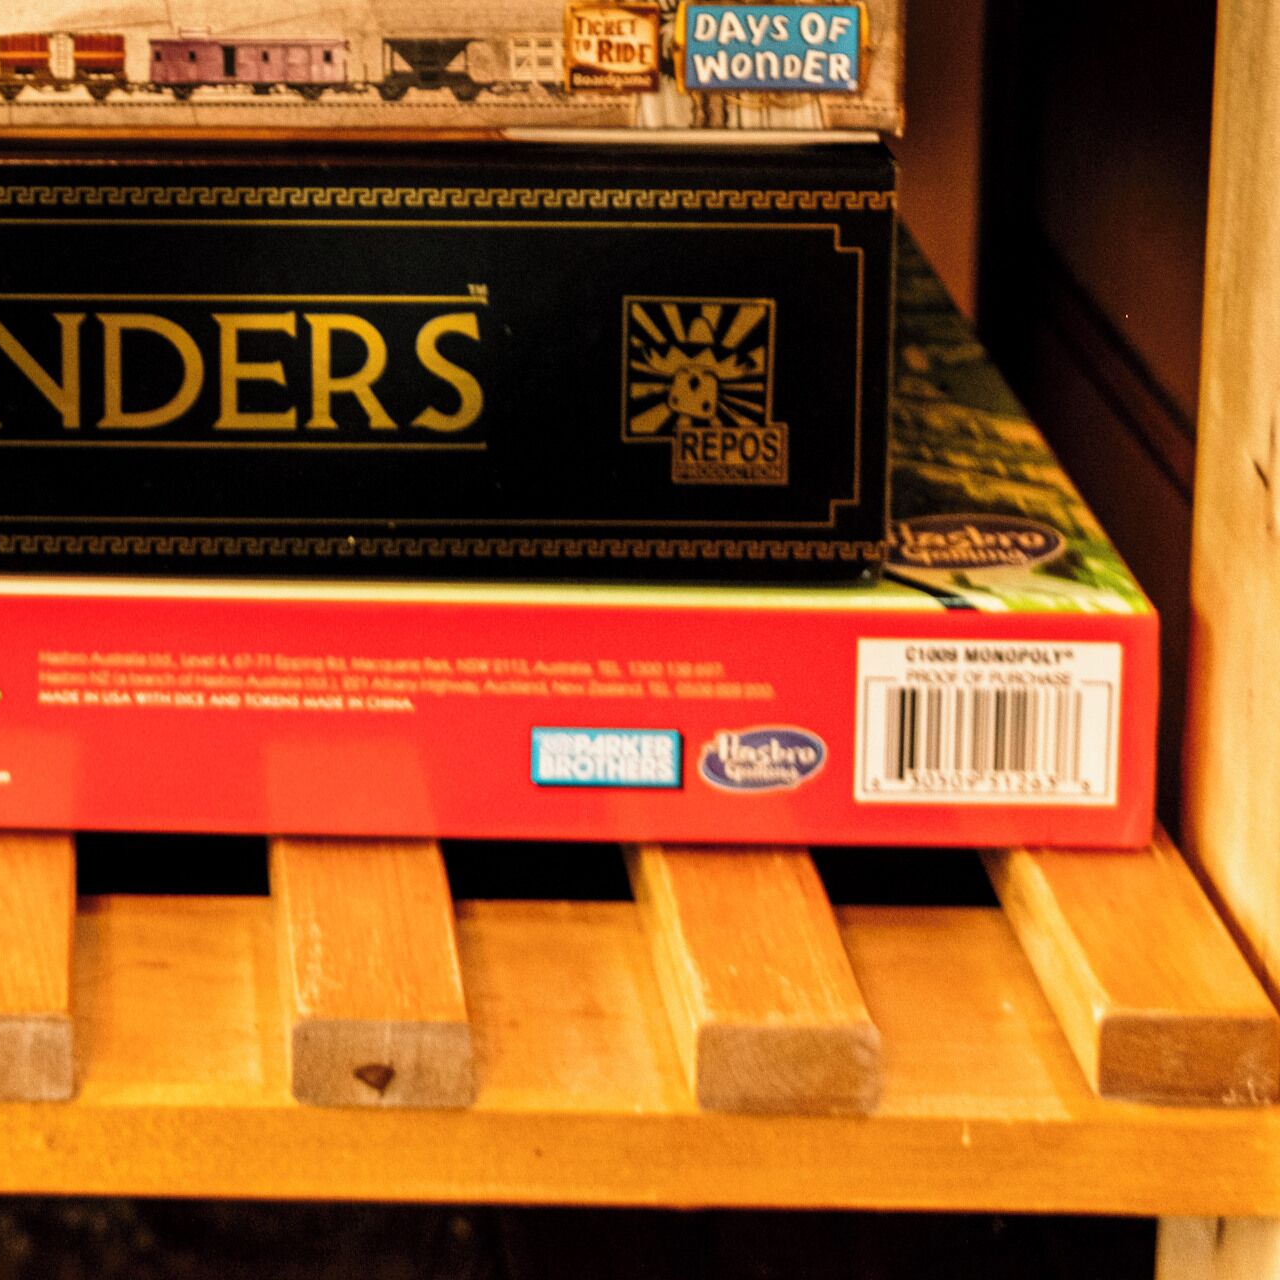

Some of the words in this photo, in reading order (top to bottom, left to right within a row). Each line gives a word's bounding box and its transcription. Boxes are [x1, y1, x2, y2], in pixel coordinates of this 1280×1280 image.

[573, 16, 638, 37] TICKET
[693, 10, 791, 46] DAYS
[800, 11, 852, 45] OF
[574, 37, 593, 53] TO
[596, 38, 653, 66] RIDE
[692, 47, 852, 85] WONDER
[680, 431, 779, 463] REPOS
[905, 669, 957, 683] PROOF
[964, 670, 982, 683] OF
[989, 671, 1071, 686] PURCHASE
[575, 734, 674, 757] PARKER
[705, 733, 818, 765] Hasbro
[538, 755, 675, 781] BROTHERS
